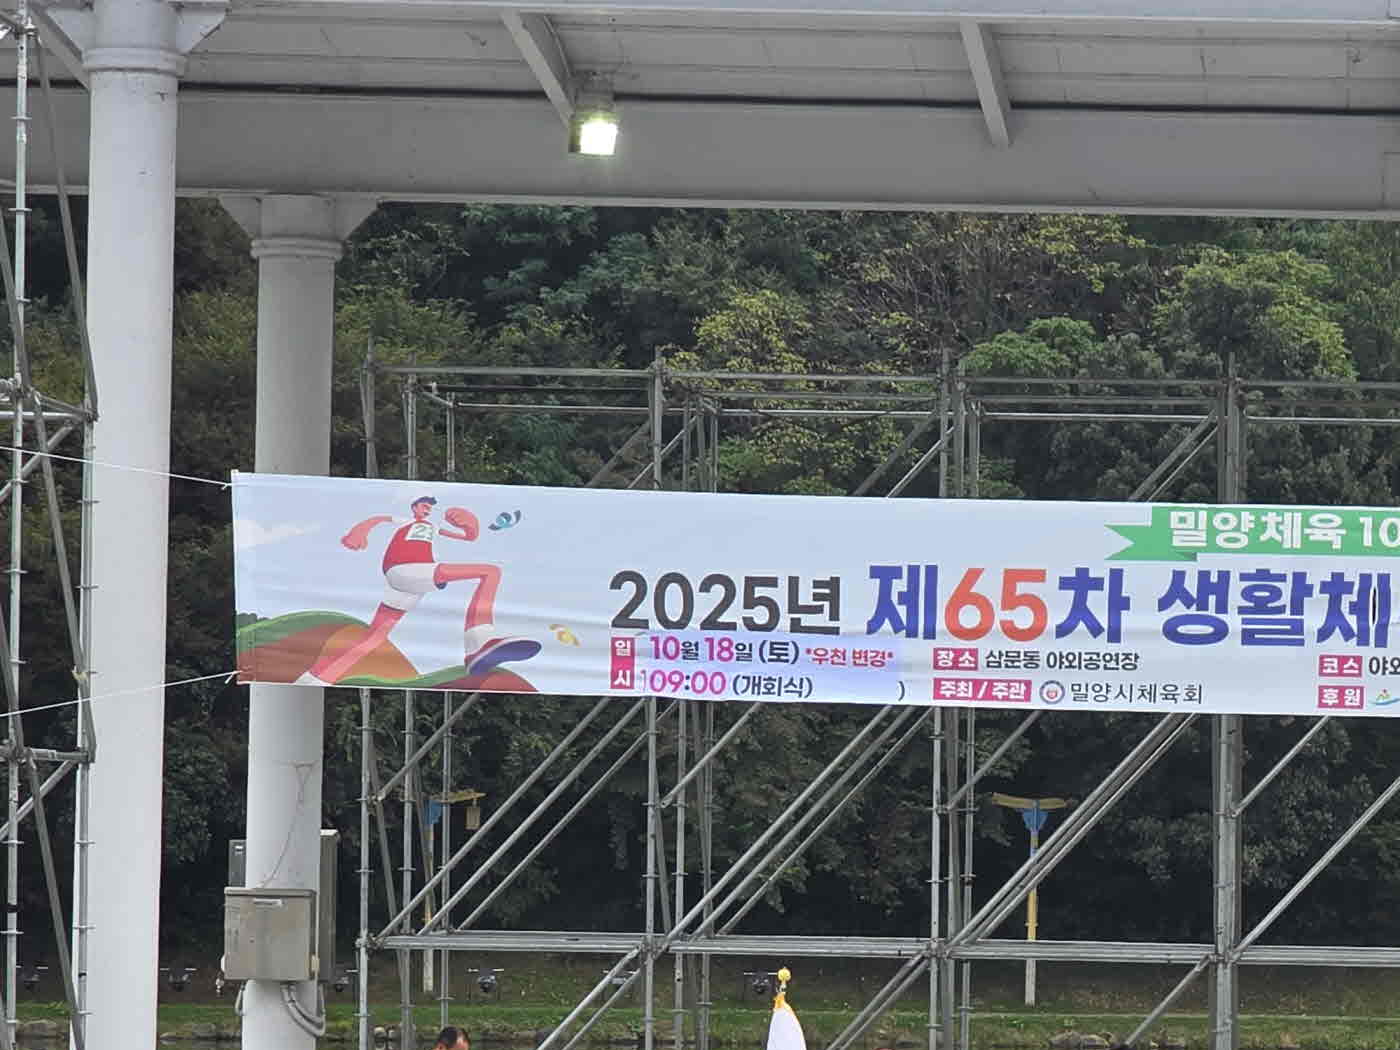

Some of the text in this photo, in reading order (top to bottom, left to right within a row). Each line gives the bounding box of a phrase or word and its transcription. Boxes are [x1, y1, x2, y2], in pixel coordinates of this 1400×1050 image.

[608, 569, 841, 635] 2025년
[866, 563, 1131, 644] 제65차
[649, 635, 699, 661] 10월
[704, 636, 753, 663] 18일
[758, 639, 800, 665] (토)
[984, 650, 1041, 670] 삼문동
[1046, 651, 1140, 672] 야외공연장
[649, 669, 727, 695] 09:00
[732, 673, 813, 699] (개회식)
[1069, 681, 1203, 705] 밀양시체육회
